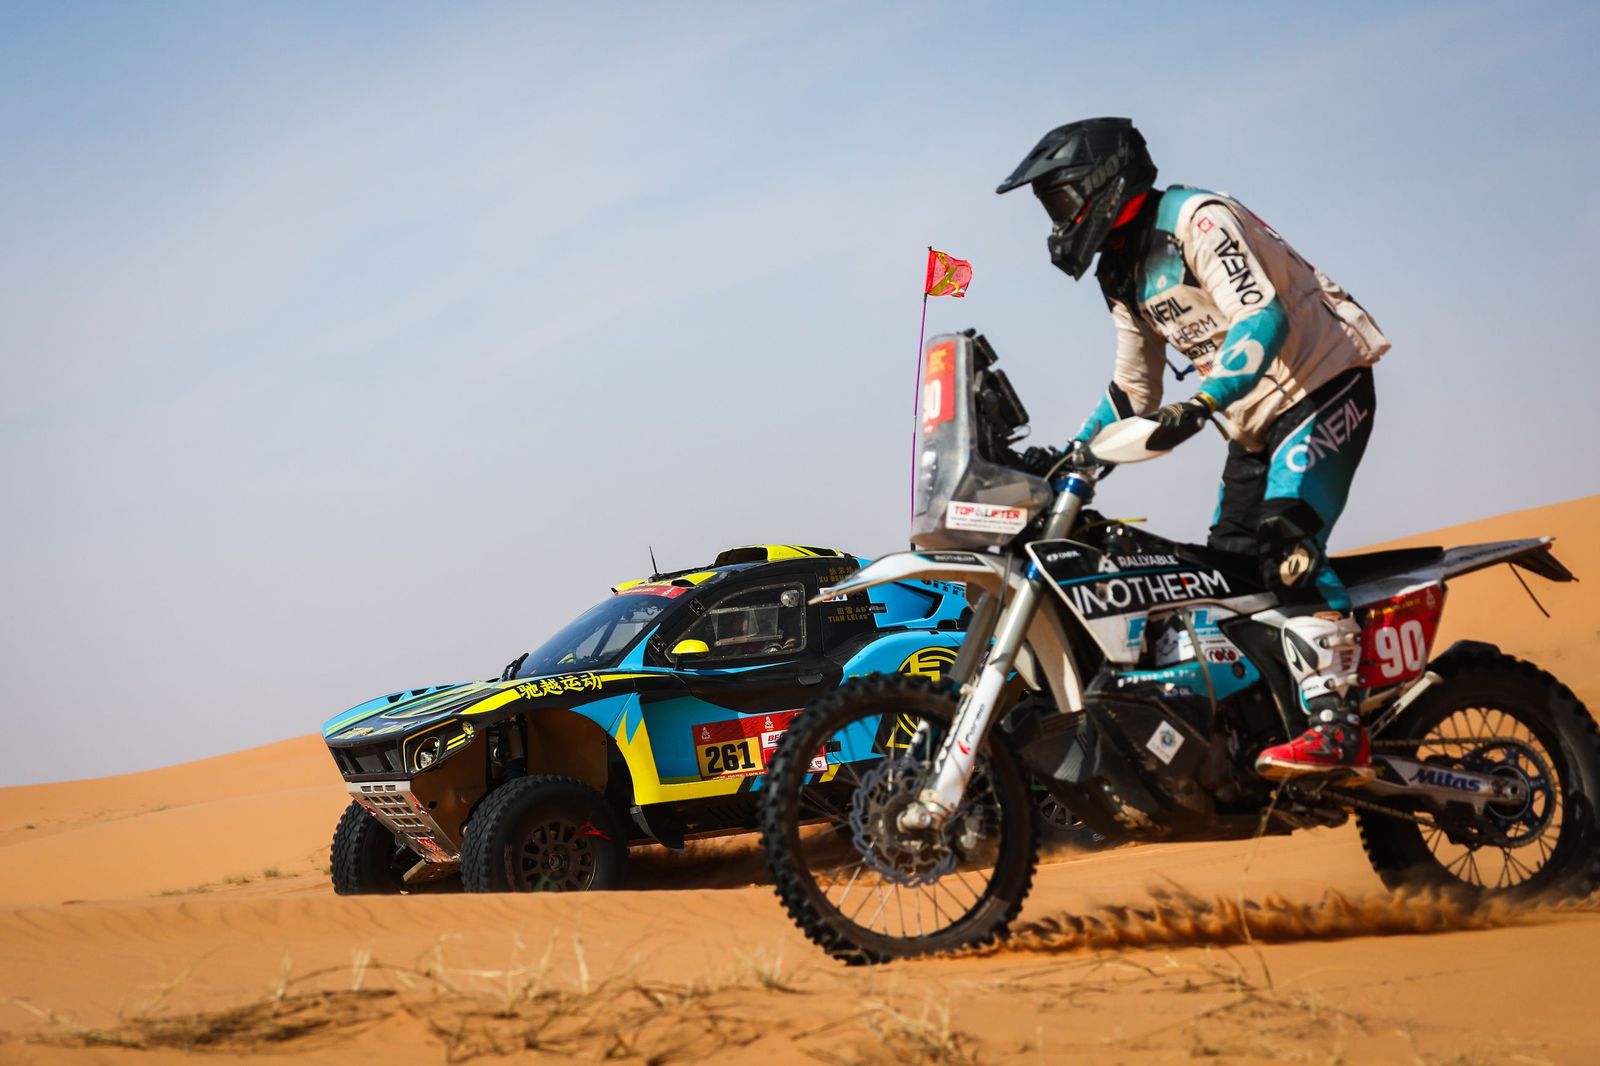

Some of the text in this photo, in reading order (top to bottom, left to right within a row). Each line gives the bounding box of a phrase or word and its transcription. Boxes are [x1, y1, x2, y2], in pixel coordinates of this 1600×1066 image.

[1143, 296, 1192, 328] NEAL
[1166, 314, 1219, 346] HERM
[1117, 554, 1180, 568] RALLYABLE
[1071, 568, 1231, 616] INOTHERM
[1375, 619, 1426, 679] 90
[517, 671, 603, 700] 驰越运动
[705, 741, 756, 774] 261
[1409, 768, 1481, 792] Mitas
